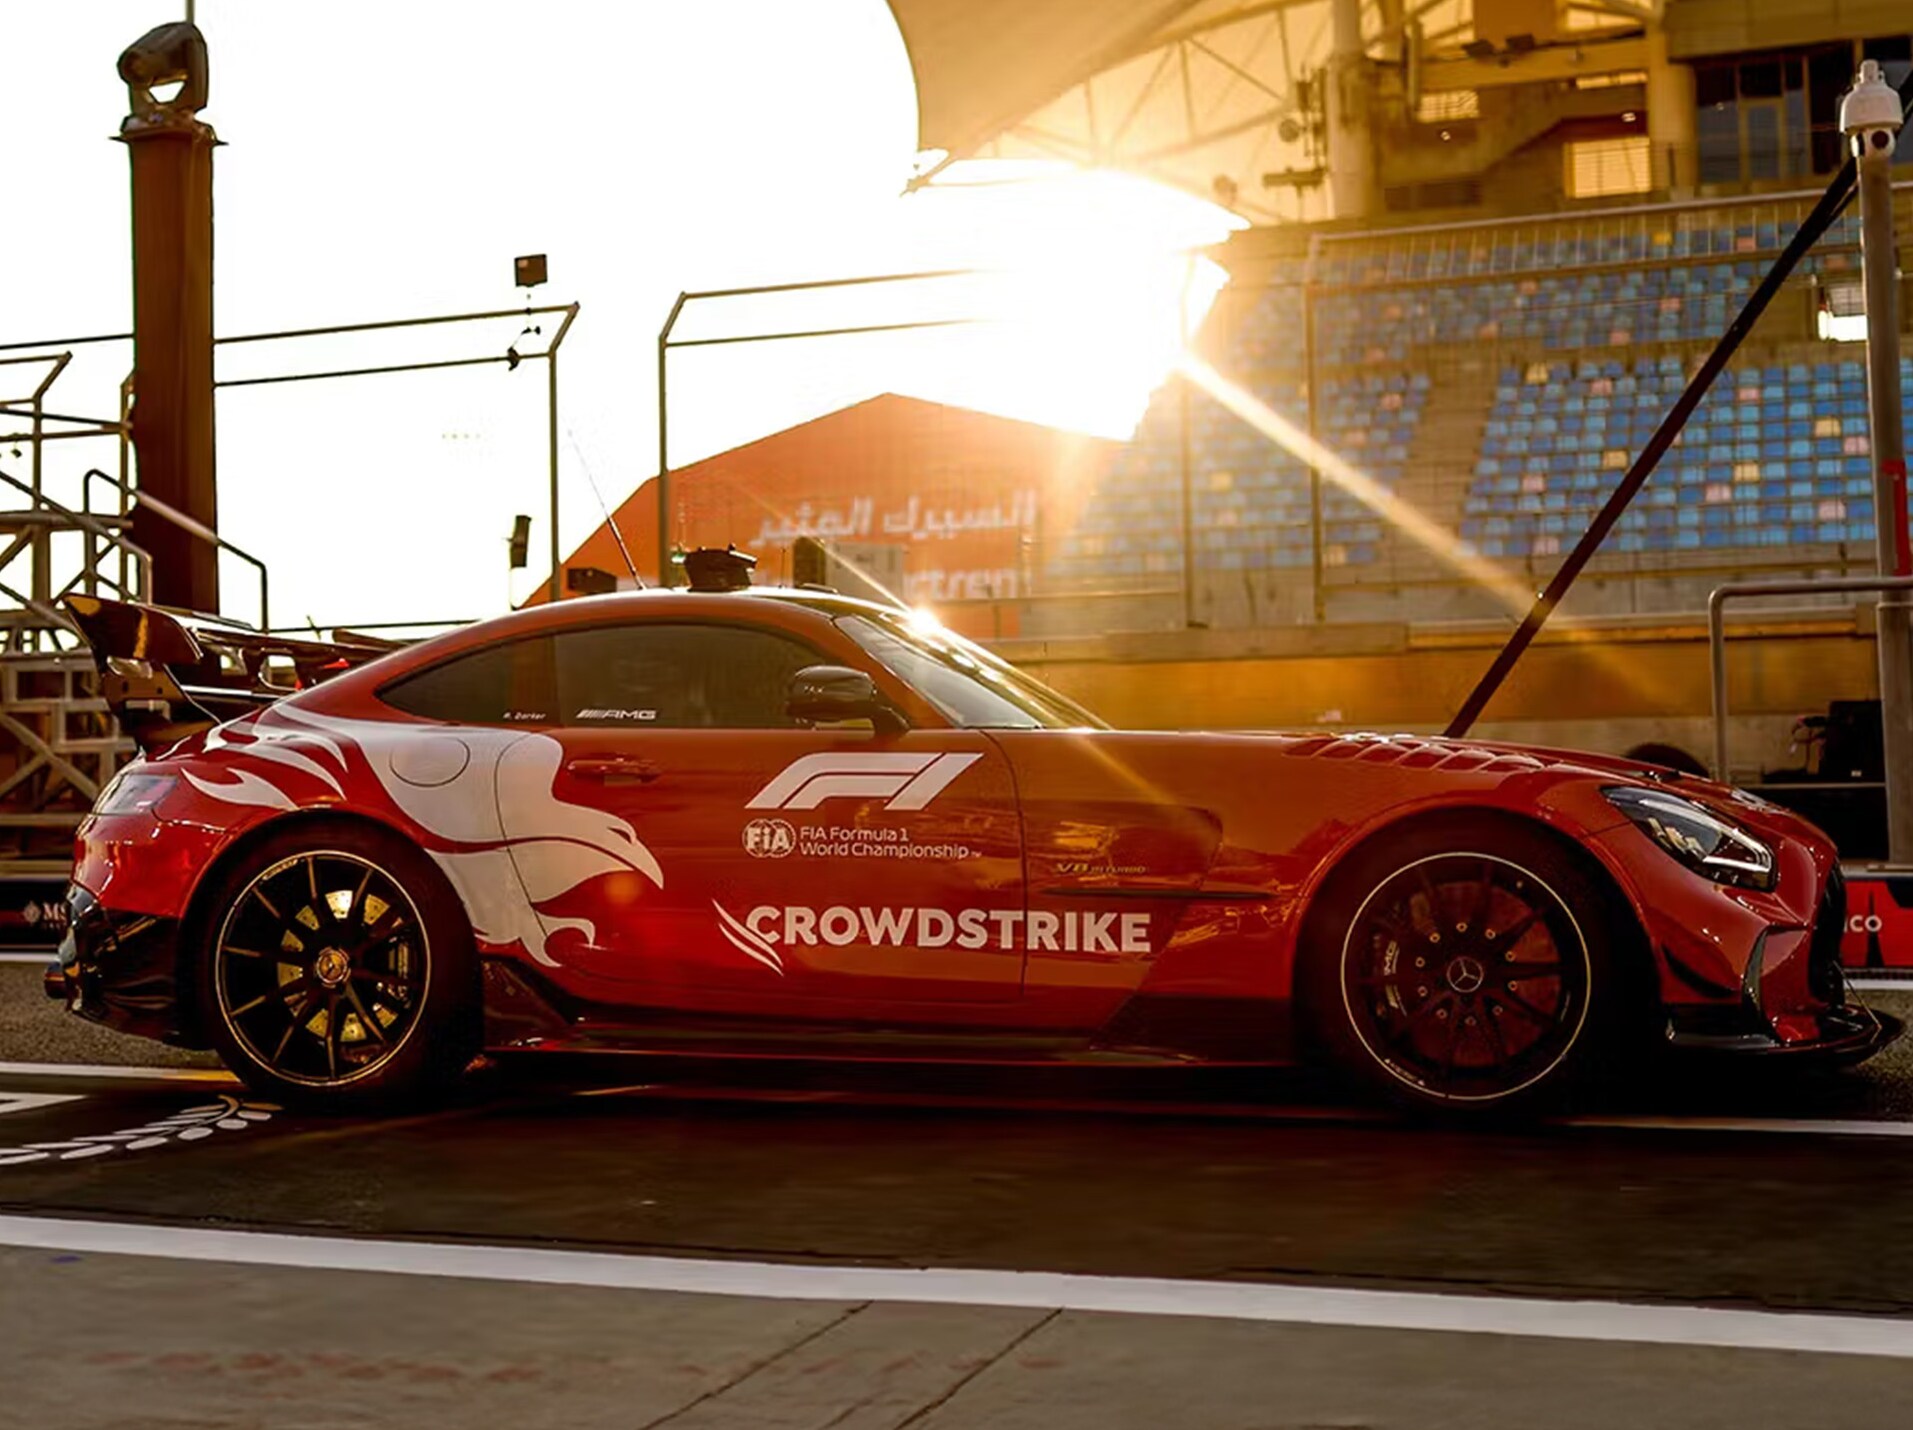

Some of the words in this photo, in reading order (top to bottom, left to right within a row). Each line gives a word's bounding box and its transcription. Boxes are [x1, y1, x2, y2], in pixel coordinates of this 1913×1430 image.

[602, 709, 657, 720] AMG
[744, 752, 985, 811] F1
[800, 826, 827, 841] FIA
[830, 826, 897, 842] Formula
[900, 828, 909, 842] 1
[800, 842, 848, 857] World
[852, 843, 969, 860] Championship
[745, 905, 1151, 953] CROWDSTRIKE
